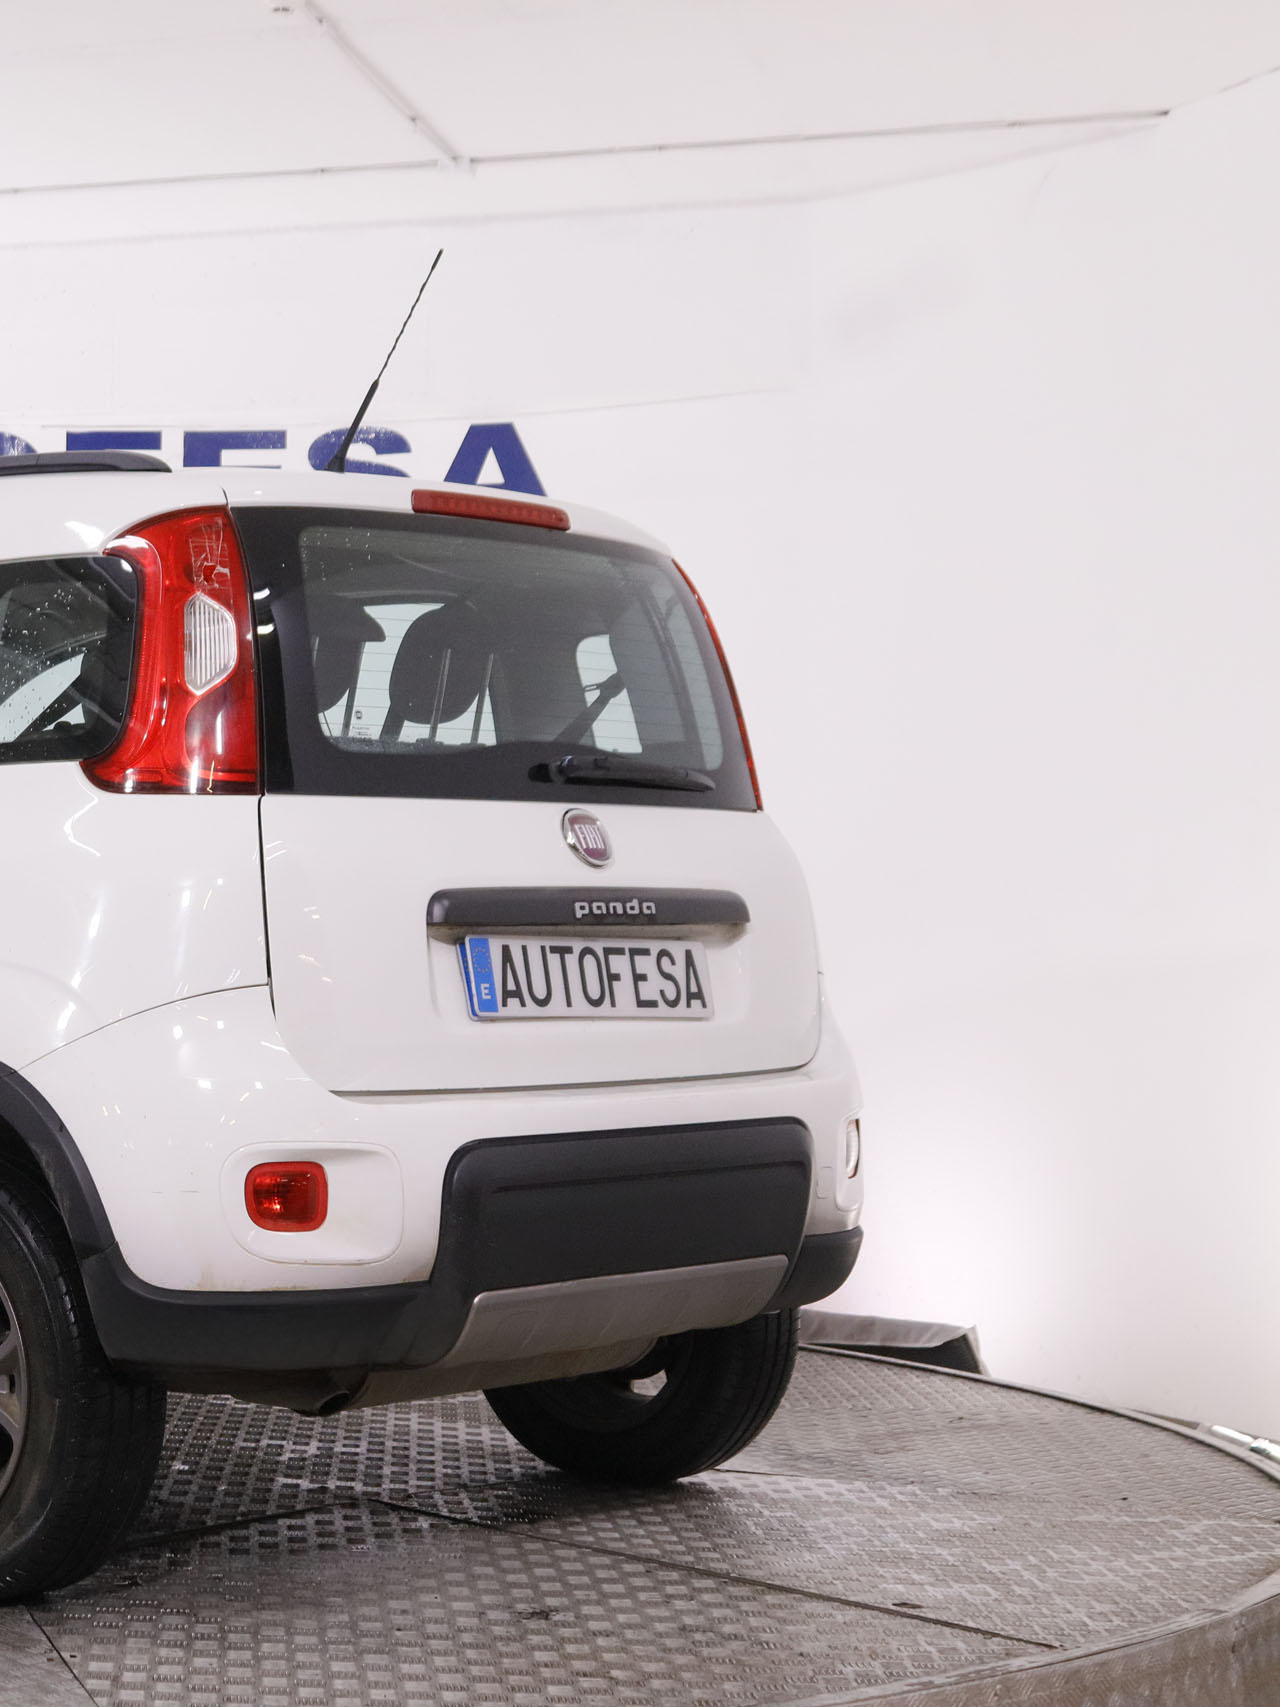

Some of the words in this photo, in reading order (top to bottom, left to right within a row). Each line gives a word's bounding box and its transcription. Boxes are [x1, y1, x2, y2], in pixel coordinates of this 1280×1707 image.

[575, 823, 605, 849] FIAT
[574, 899, 657, 919] panda
[501, 944, 708, 1009] AUTOFESA
[481, 983, 492, 999] E
